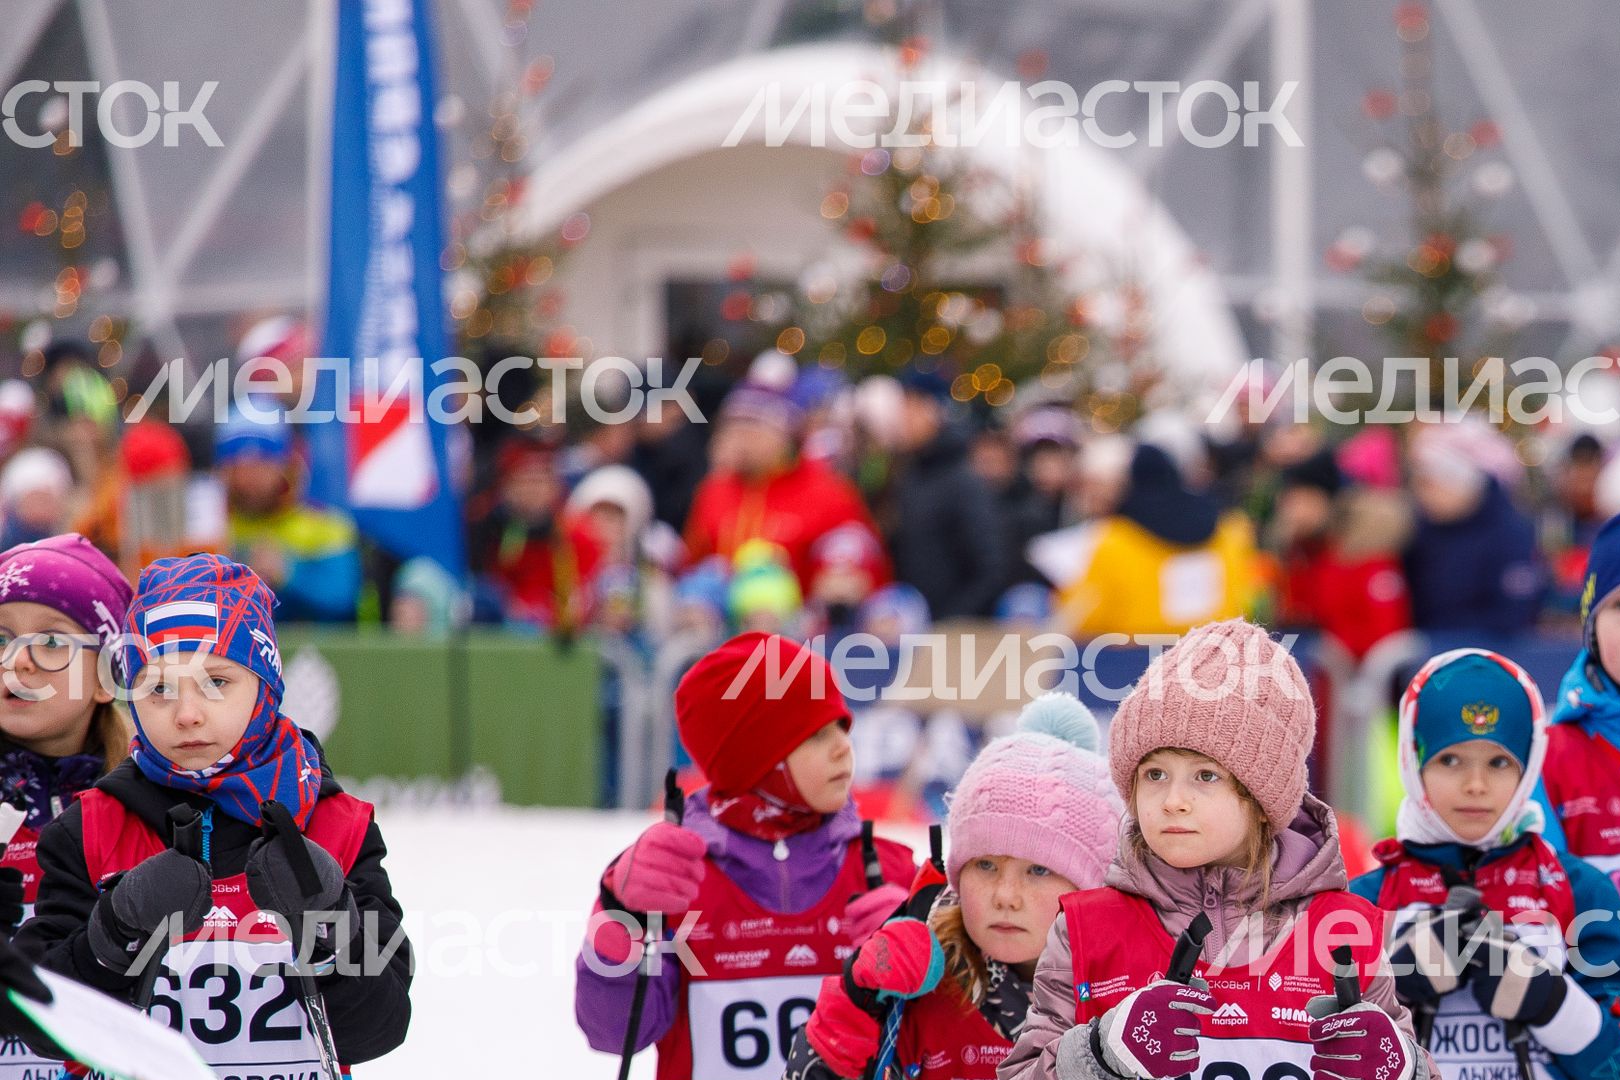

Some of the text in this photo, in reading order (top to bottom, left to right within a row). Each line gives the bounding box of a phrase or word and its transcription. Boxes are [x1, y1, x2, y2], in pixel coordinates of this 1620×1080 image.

[1207, 980, 1251, 991] СКОВЬЯ
[1212, 1016, 1249, 1027] marsport
[1322, 1015, 1360, 1034] ziener
